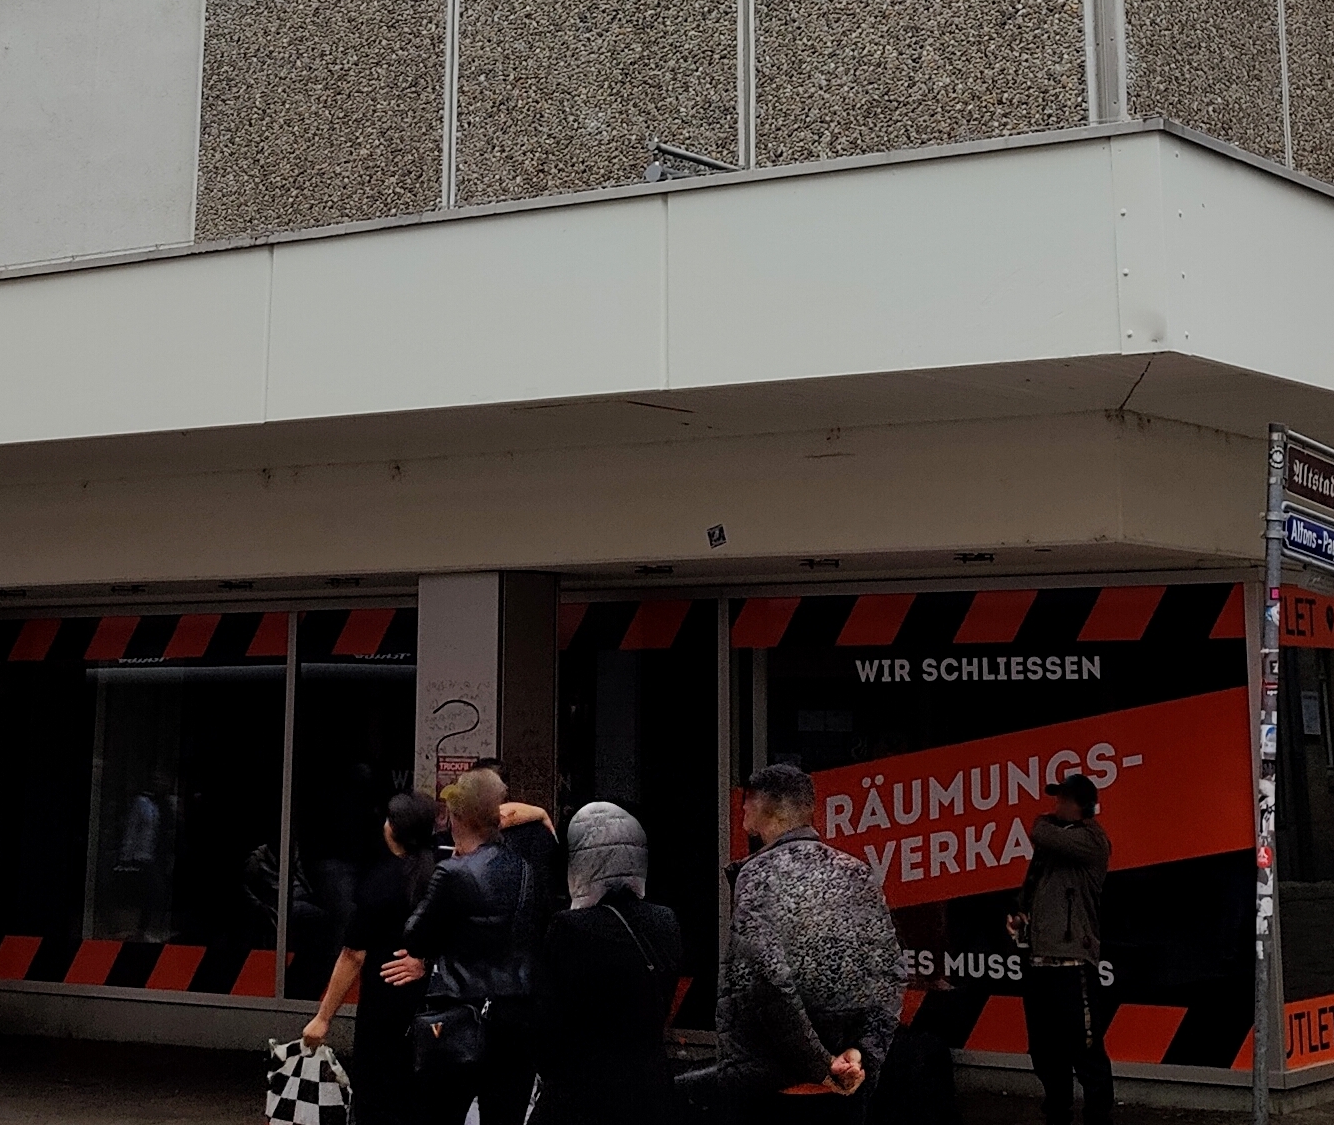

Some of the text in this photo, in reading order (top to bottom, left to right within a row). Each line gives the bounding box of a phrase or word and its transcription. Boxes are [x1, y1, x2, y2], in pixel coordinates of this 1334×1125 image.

[1281, 596, 1316, 637] LET
[855, 655, 1101, 683] WIR SCHLIESSEN
[825, 742, 1144, 839] RÄUMUNGS-
[863, 816, 1035, 883] VERKA
[944, 951, 1023, 980] MUSS
